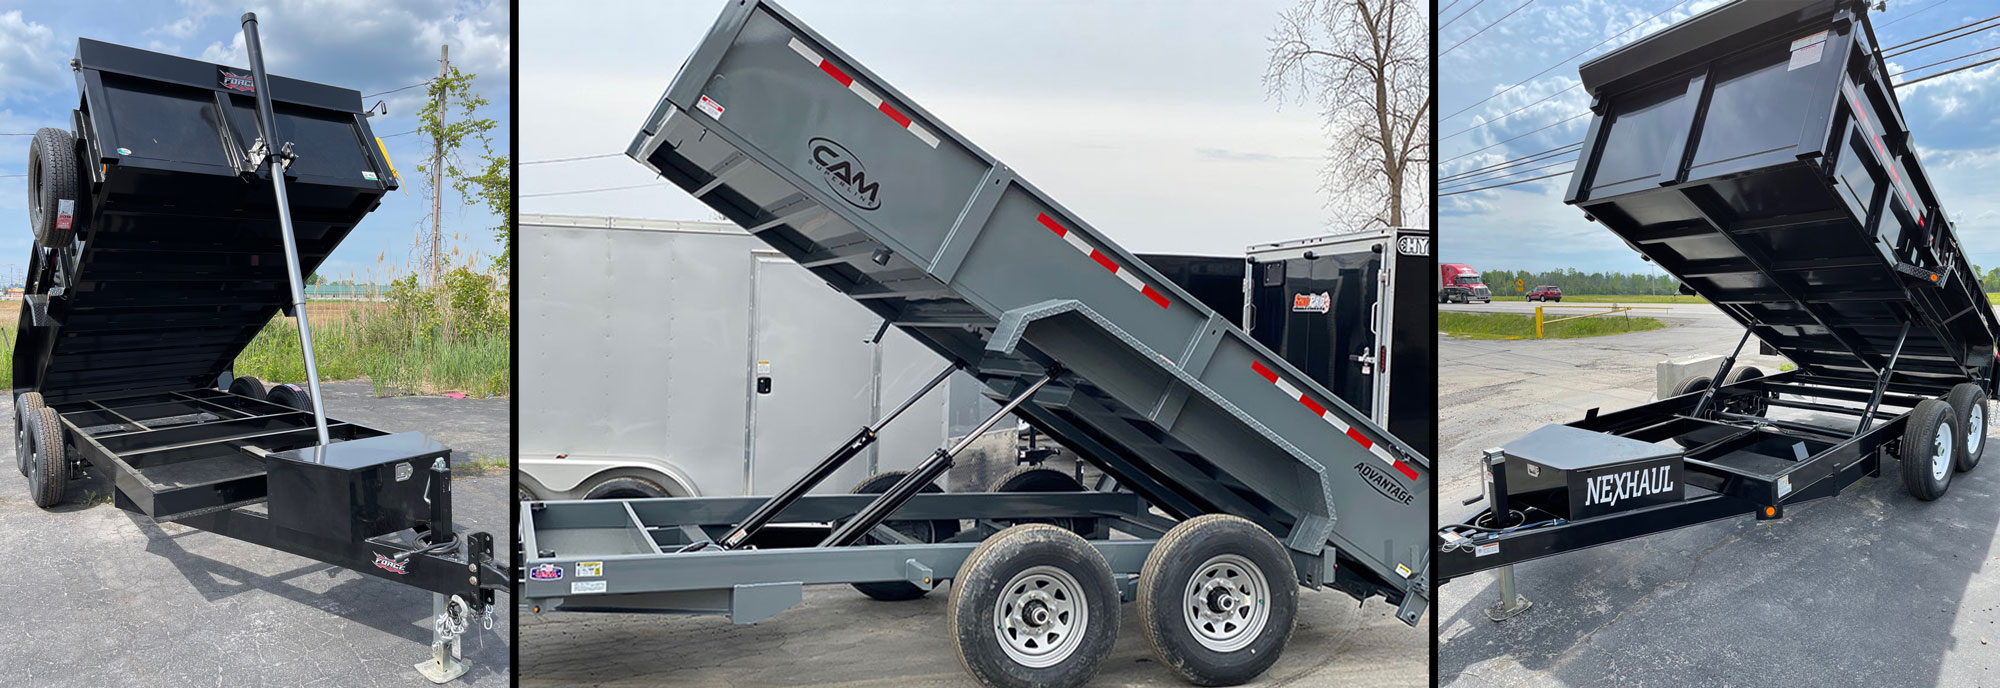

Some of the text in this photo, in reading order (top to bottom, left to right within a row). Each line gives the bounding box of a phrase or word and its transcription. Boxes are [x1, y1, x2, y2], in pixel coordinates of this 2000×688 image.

[223, 76, 254, 87] FORC
[807, 159, 873, 207] SUPERLINE
[813, 145, 879, 202] CAM
[1406, 236, 1429, 254] HY
[1353, 462, 1414, 505] ADVANTAGE
[1585, 465, 1674, 506] NEXHAUL
